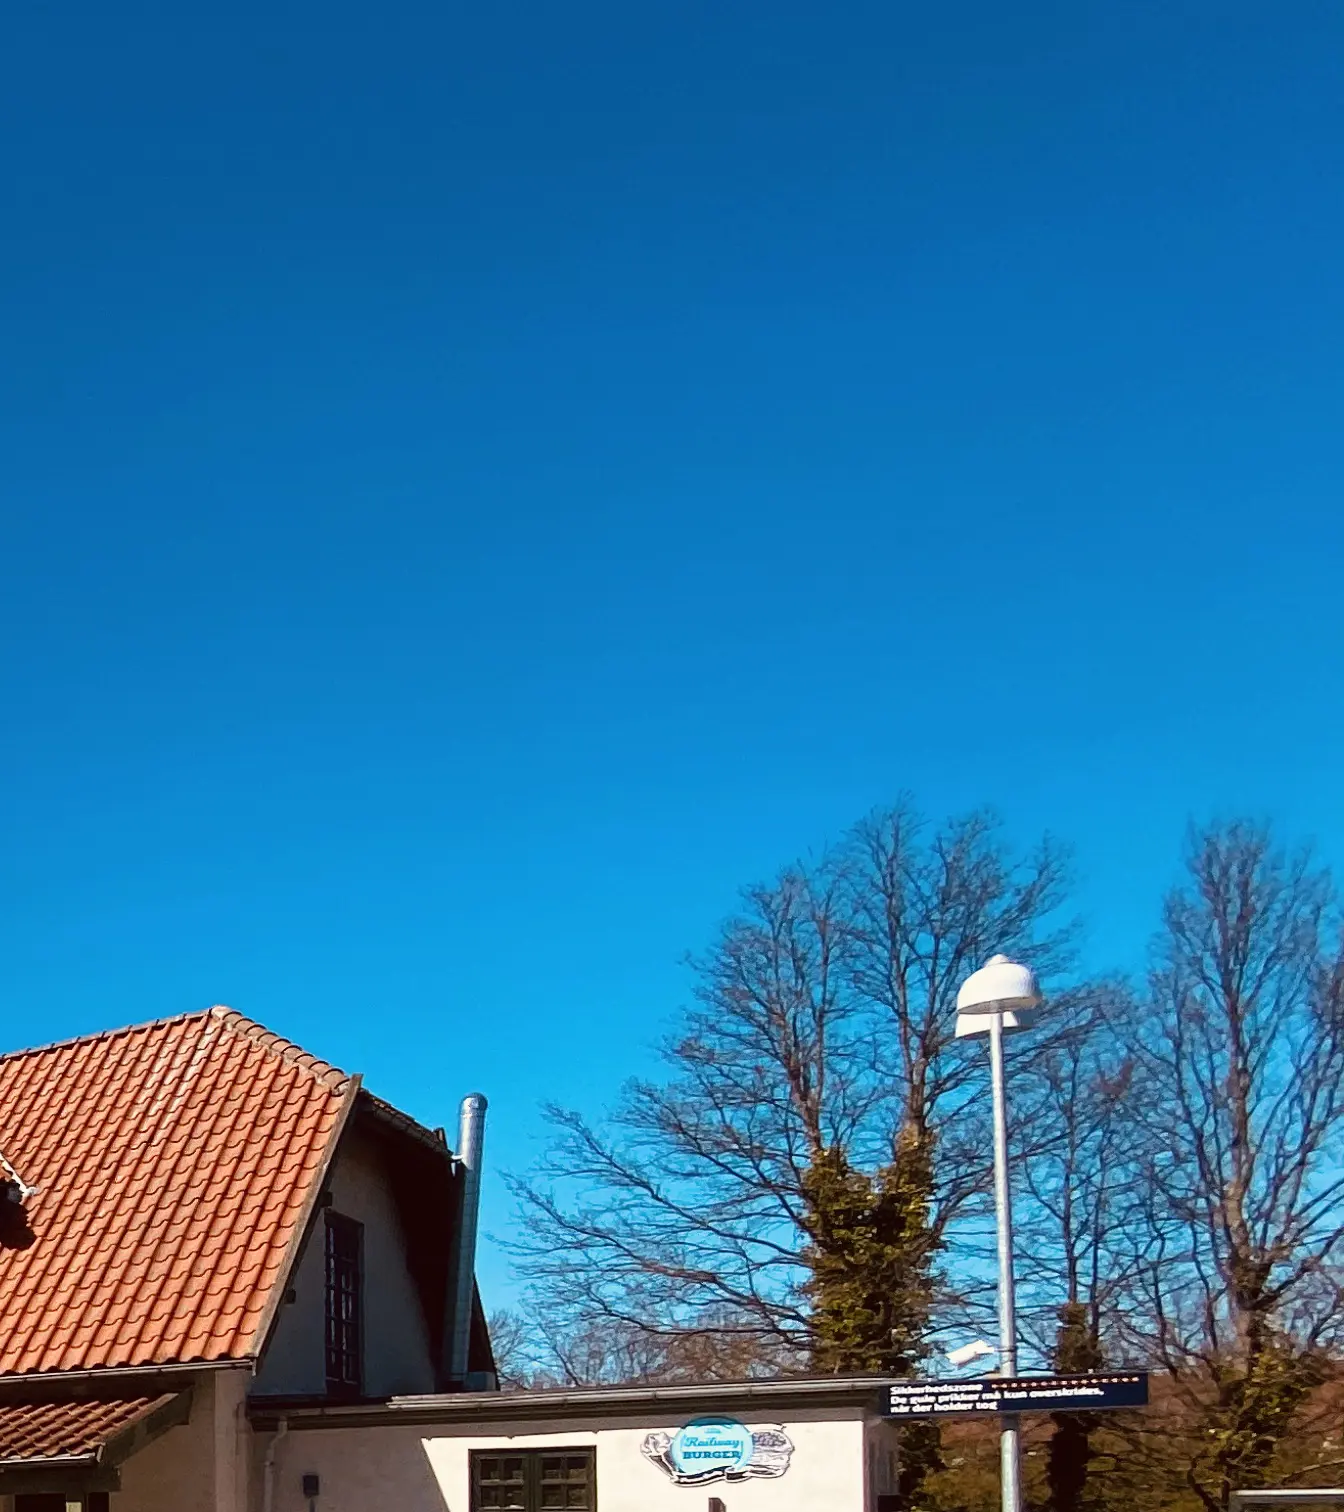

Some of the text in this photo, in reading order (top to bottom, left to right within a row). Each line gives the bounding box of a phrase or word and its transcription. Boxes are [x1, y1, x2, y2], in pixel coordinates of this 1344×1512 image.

[891, 1396, 907, 1404] De
[684, 1437, 740, 1448] Railway
[682, 1451, 741, 1460] BURGER
